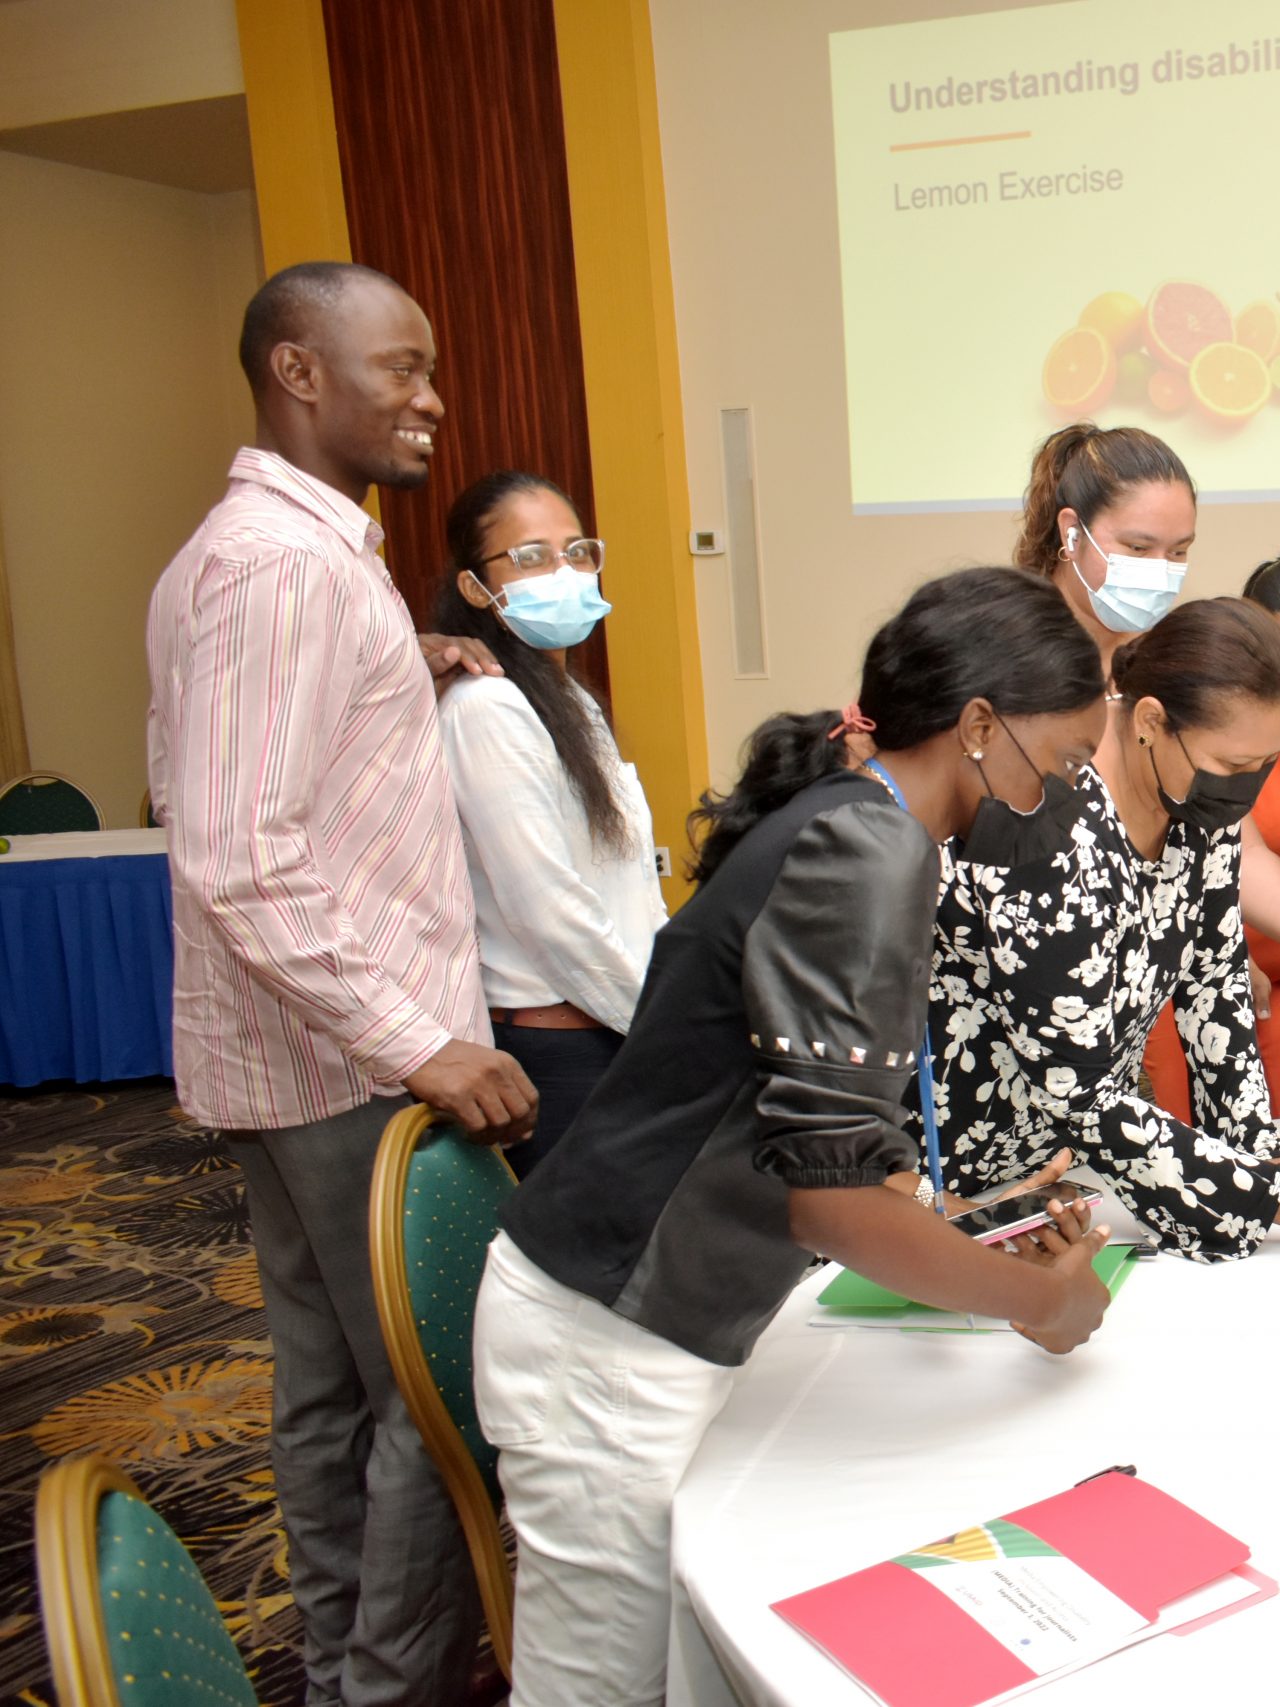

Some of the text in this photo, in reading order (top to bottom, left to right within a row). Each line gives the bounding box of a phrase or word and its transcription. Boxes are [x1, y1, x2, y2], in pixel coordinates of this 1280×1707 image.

[889, 59, 1140, 114] Understanding
[893, 164, 1125, 212] Lemon Exercise
[996, 1588, 1030, 1614] September
[1032, 1618, 1050, 1632] 2022
[1013, 1586, 1038, 1609] Training
[1036, 1606, 1047, 1616] for
